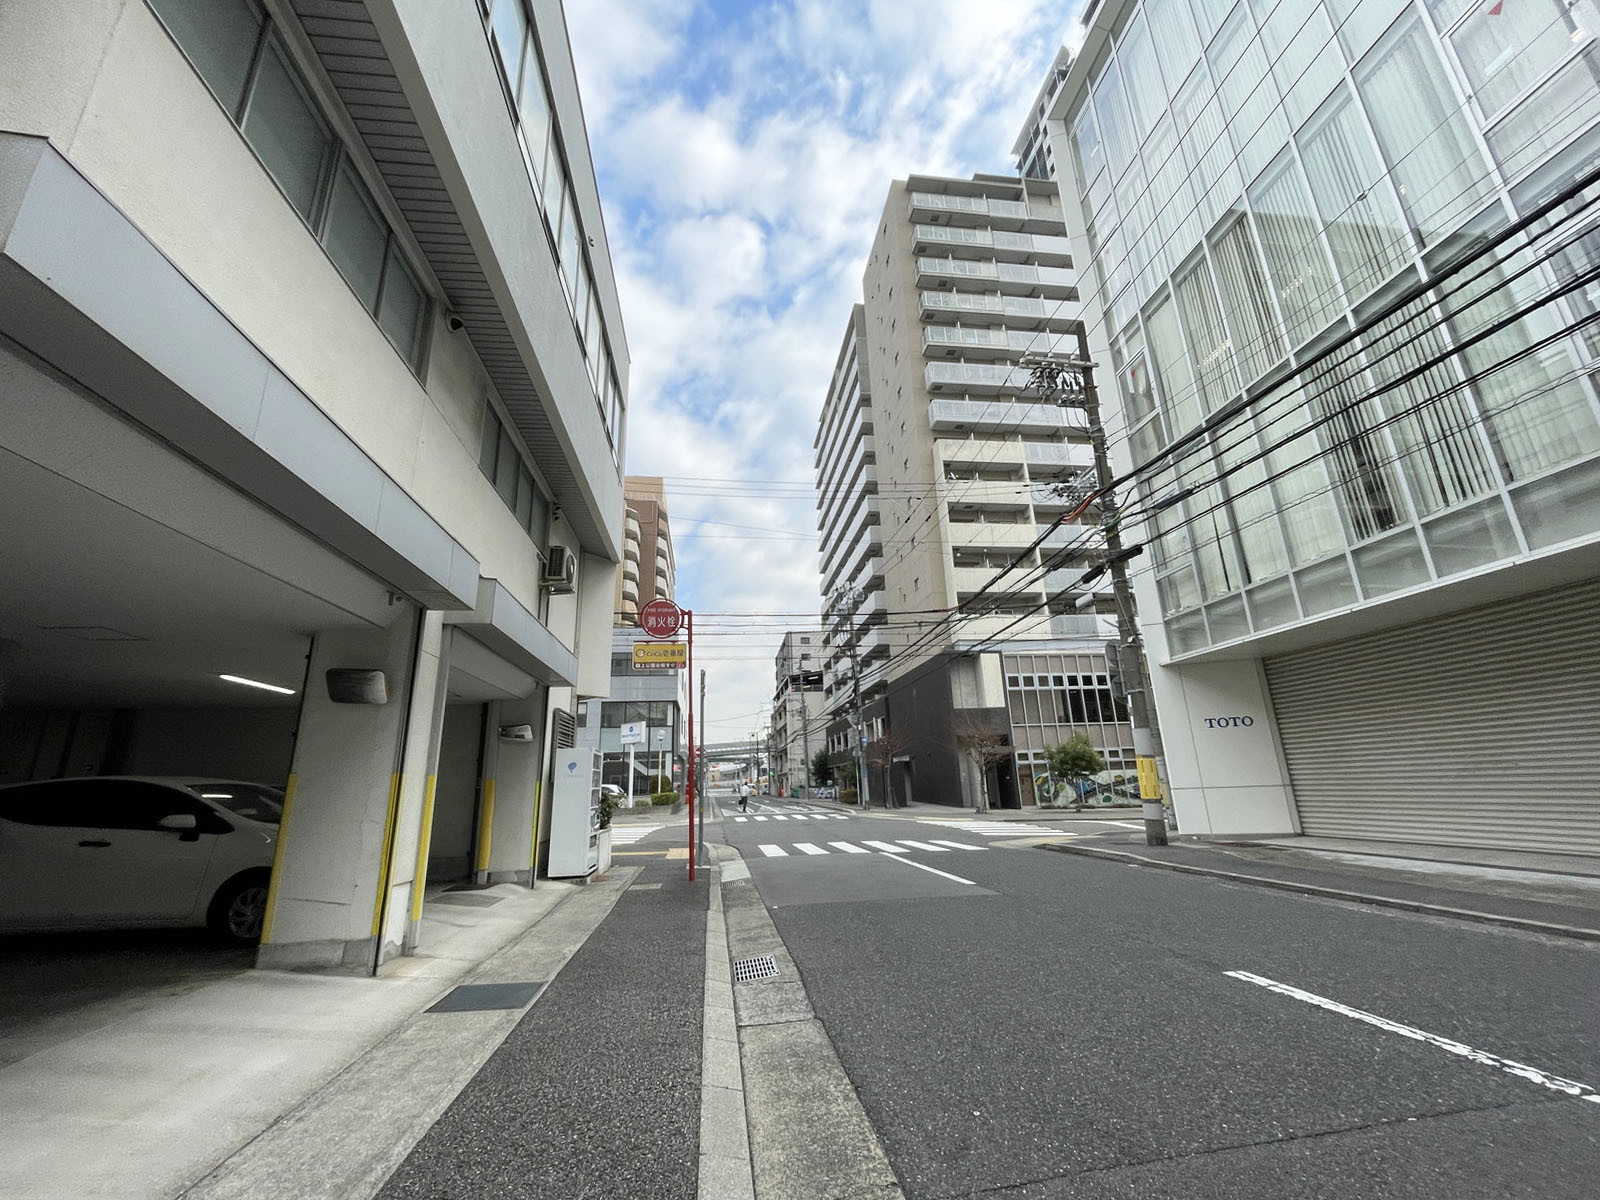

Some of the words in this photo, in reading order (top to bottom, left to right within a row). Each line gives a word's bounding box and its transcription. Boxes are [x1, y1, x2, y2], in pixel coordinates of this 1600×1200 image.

[648, 616, 675, 628] 消火栓
[1204, 715, 1253, 728] TOTO
